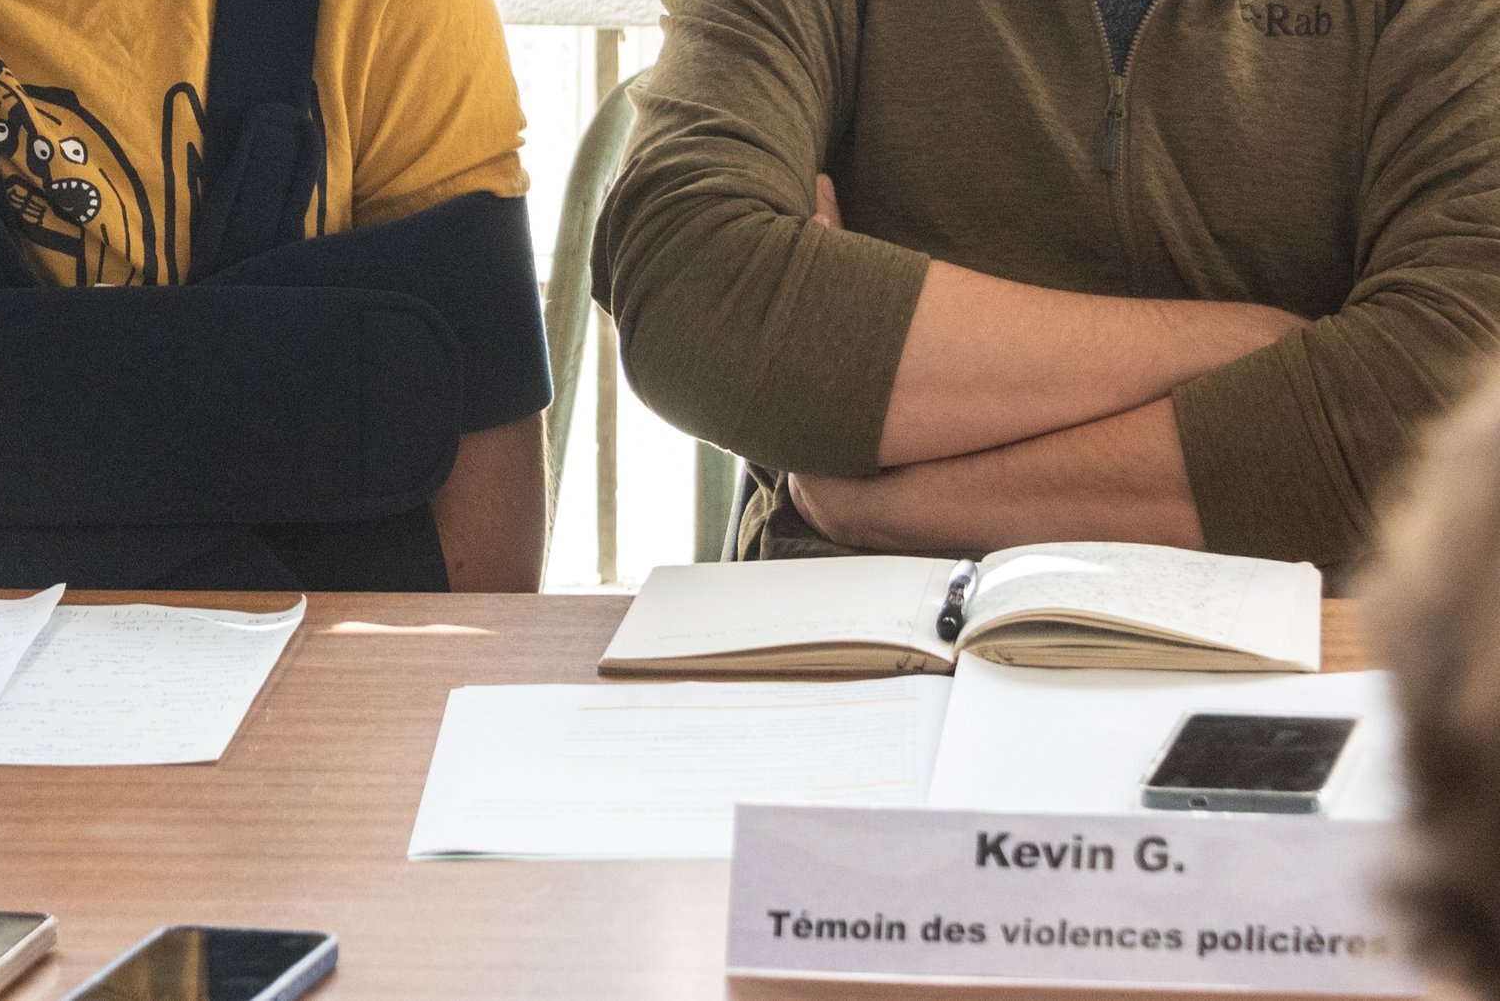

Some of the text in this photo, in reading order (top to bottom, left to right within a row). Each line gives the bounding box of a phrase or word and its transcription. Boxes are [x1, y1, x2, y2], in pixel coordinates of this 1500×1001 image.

[1263, 3, 1333, 38] Rab
[974, 830, 1185, 872] Kevin G.
[766, 907, 906, 941] Témoin
[919, 913, 987, 943] des
[1001, 916, 1183, 950] violences
